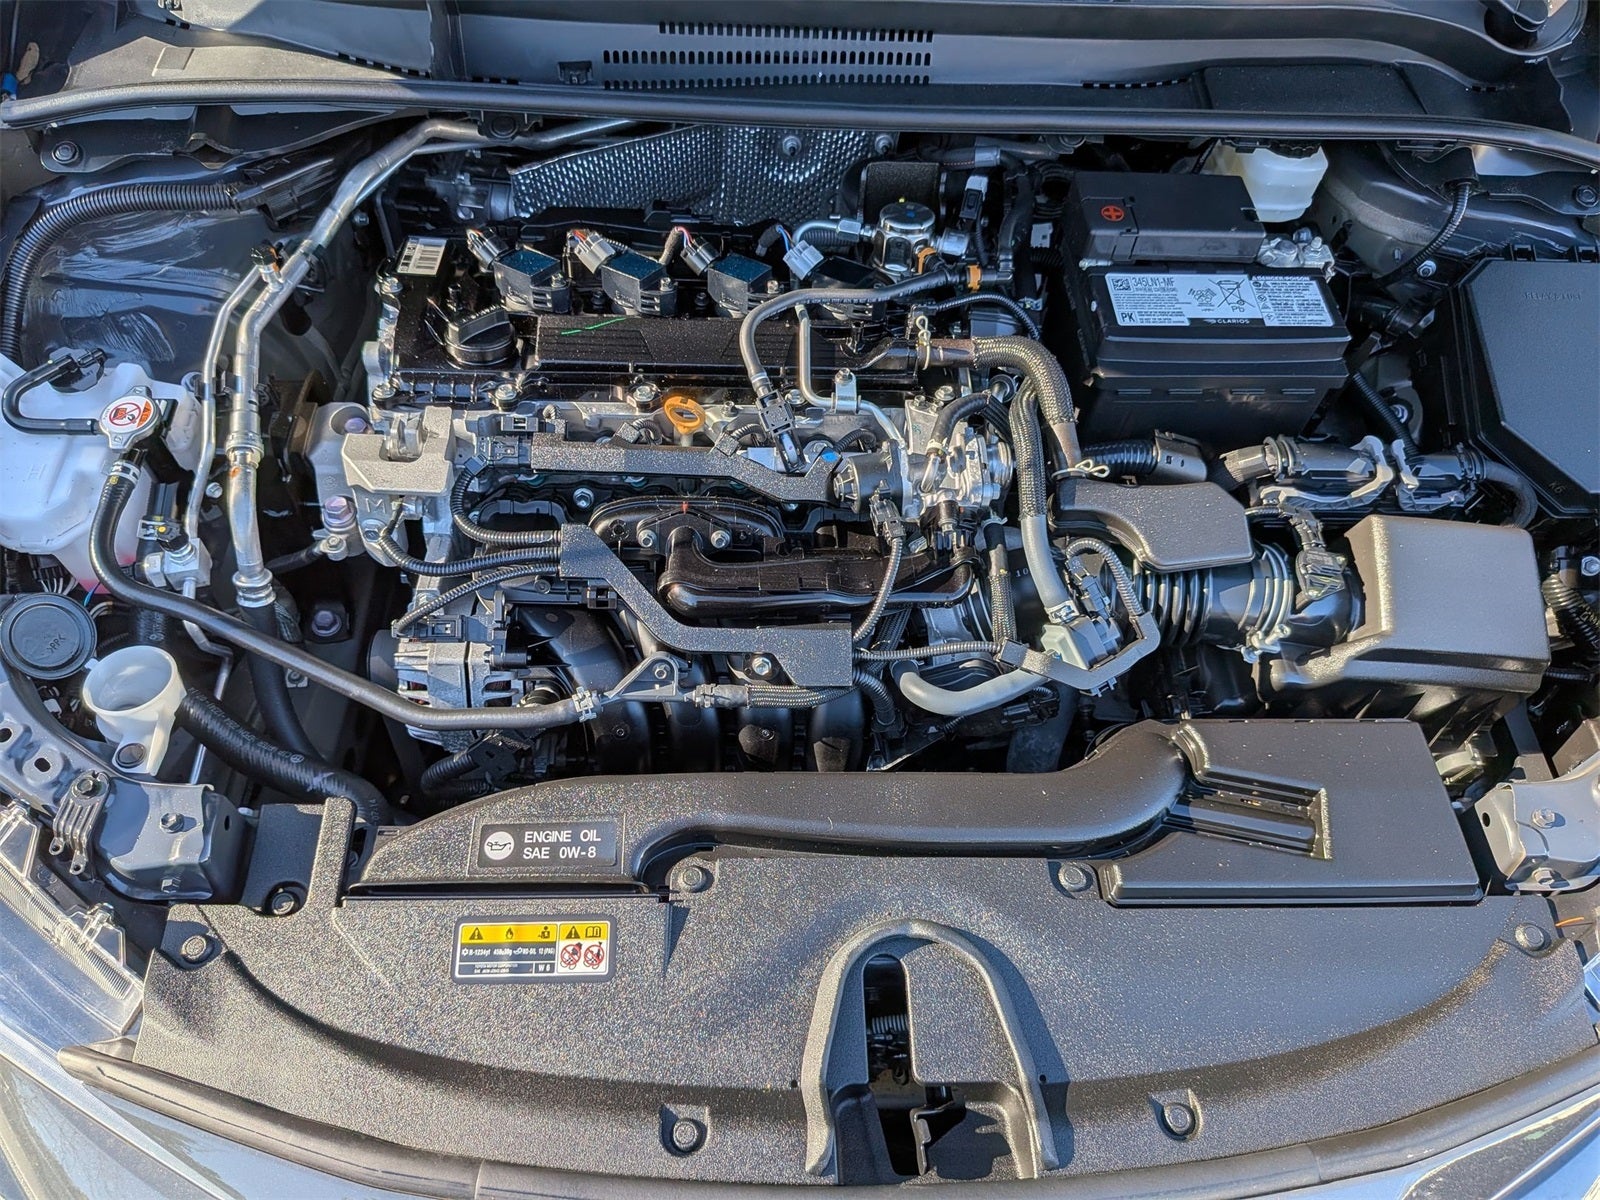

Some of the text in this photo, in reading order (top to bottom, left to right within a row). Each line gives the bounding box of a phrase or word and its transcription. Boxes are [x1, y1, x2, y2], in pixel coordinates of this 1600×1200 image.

[1132, 277, 1174, 287] 345LN1-MF
[1231, 305, 1245, 313] Pb
[1121, 312, 1136, 322] PK
[524, 829, 601, 843] ENGINE OIL
[523, 846, 597, 859] SAE 0W-8
[539, 964, 544, 972] W
